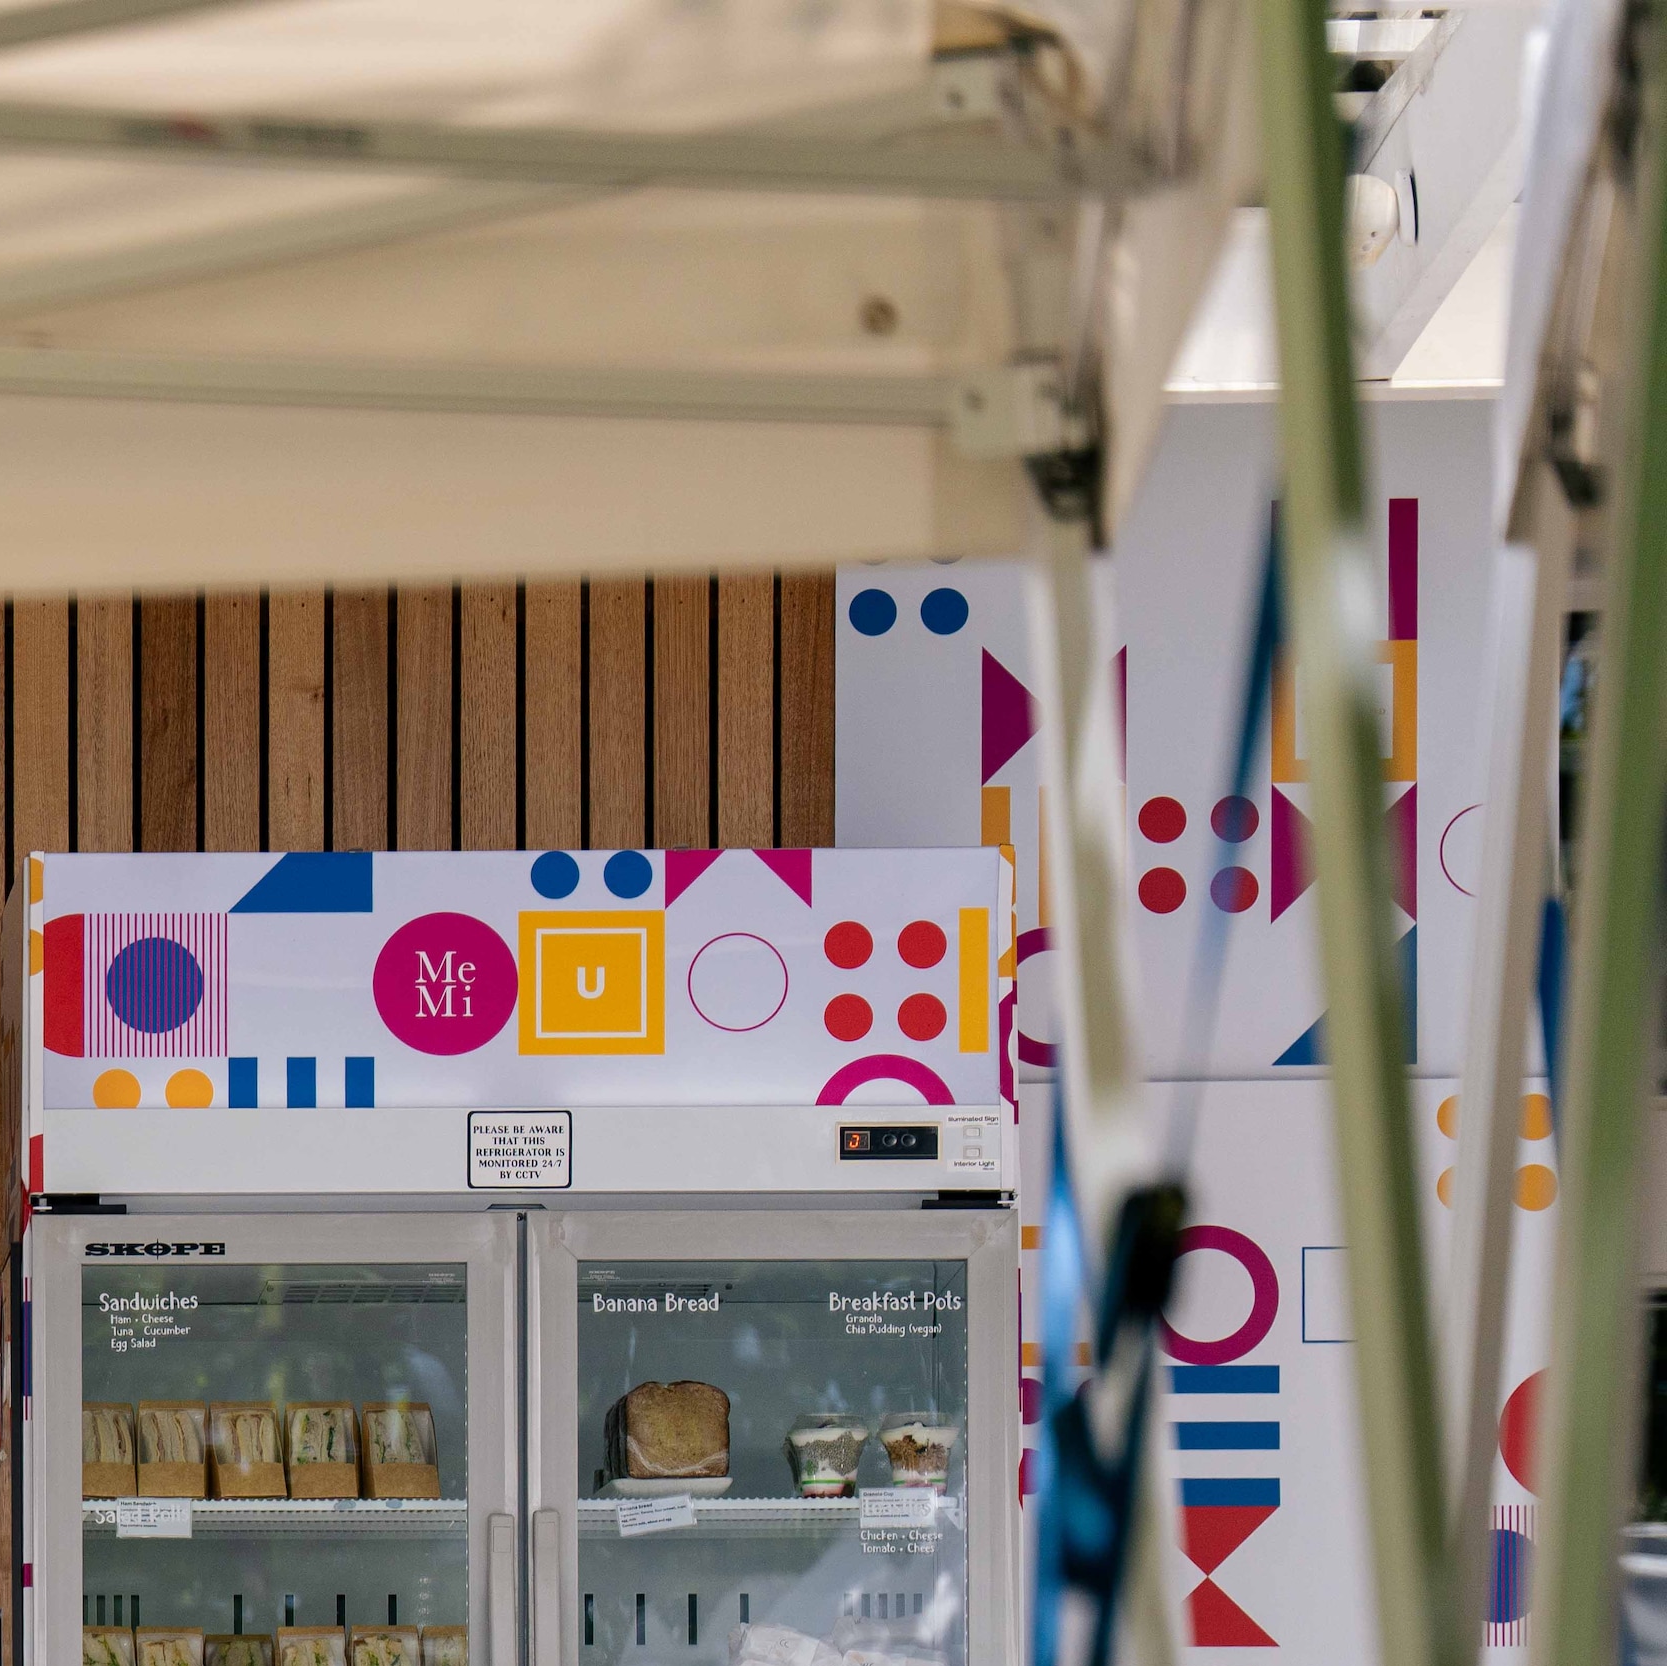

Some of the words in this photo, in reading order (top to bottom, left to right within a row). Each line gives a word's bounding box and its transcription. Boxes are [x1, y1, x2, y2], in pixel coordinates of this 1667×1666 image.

[415, 951, 475, 984] Me
[578, 967, 605, 1000] U
[415, 986, 474, 1018] Mi
[473, 1125, 509, 1134] PLEASE
[513, 1125, 524, 1134] BE
[529, 1125, 563, 1134] AWARE
[492, 1137, 519, 1145] THAT
[522, 1137, 545, 1145] THIS
[476, 1148, 552, 1157] REFRIGERATOR
[556, 1148, 565, 1157] IS
[479, 1159, 538, 1168] MONITORED
[542, 1159, 562, 1168] 24/7
[979, 1160, 995, 1168] Light
[500, 1170, 512, 1179] BY
[515, 1170, 541, 1179] CCTV
[85, 1241, 226, 1258] SKOPE
[99, 1291, 198, 1312] Sandwiches
[593, 1293, 657, 1313] Banana
[666, 1292, 719, 1312] Bread
[829, 1291, 916, 1312] Breakfast
[923, 1290, 962, 1311] Pots
[110, 1314, 132, 1324] Ham
[142, 1314, 174, 1324] Cheese
[846, 1314, 882, 1323] Granola
[144, 1325, 191, 1336] Cucumber
[846, 1325, 865, 1334] Chia
[869, 1325, 905, 1337] Pudding
[909, 1324, 942, 1337] (vegan)
[111, 1338, 128, 1353] Egg
[131, 1337, 156, 1348] Salad
